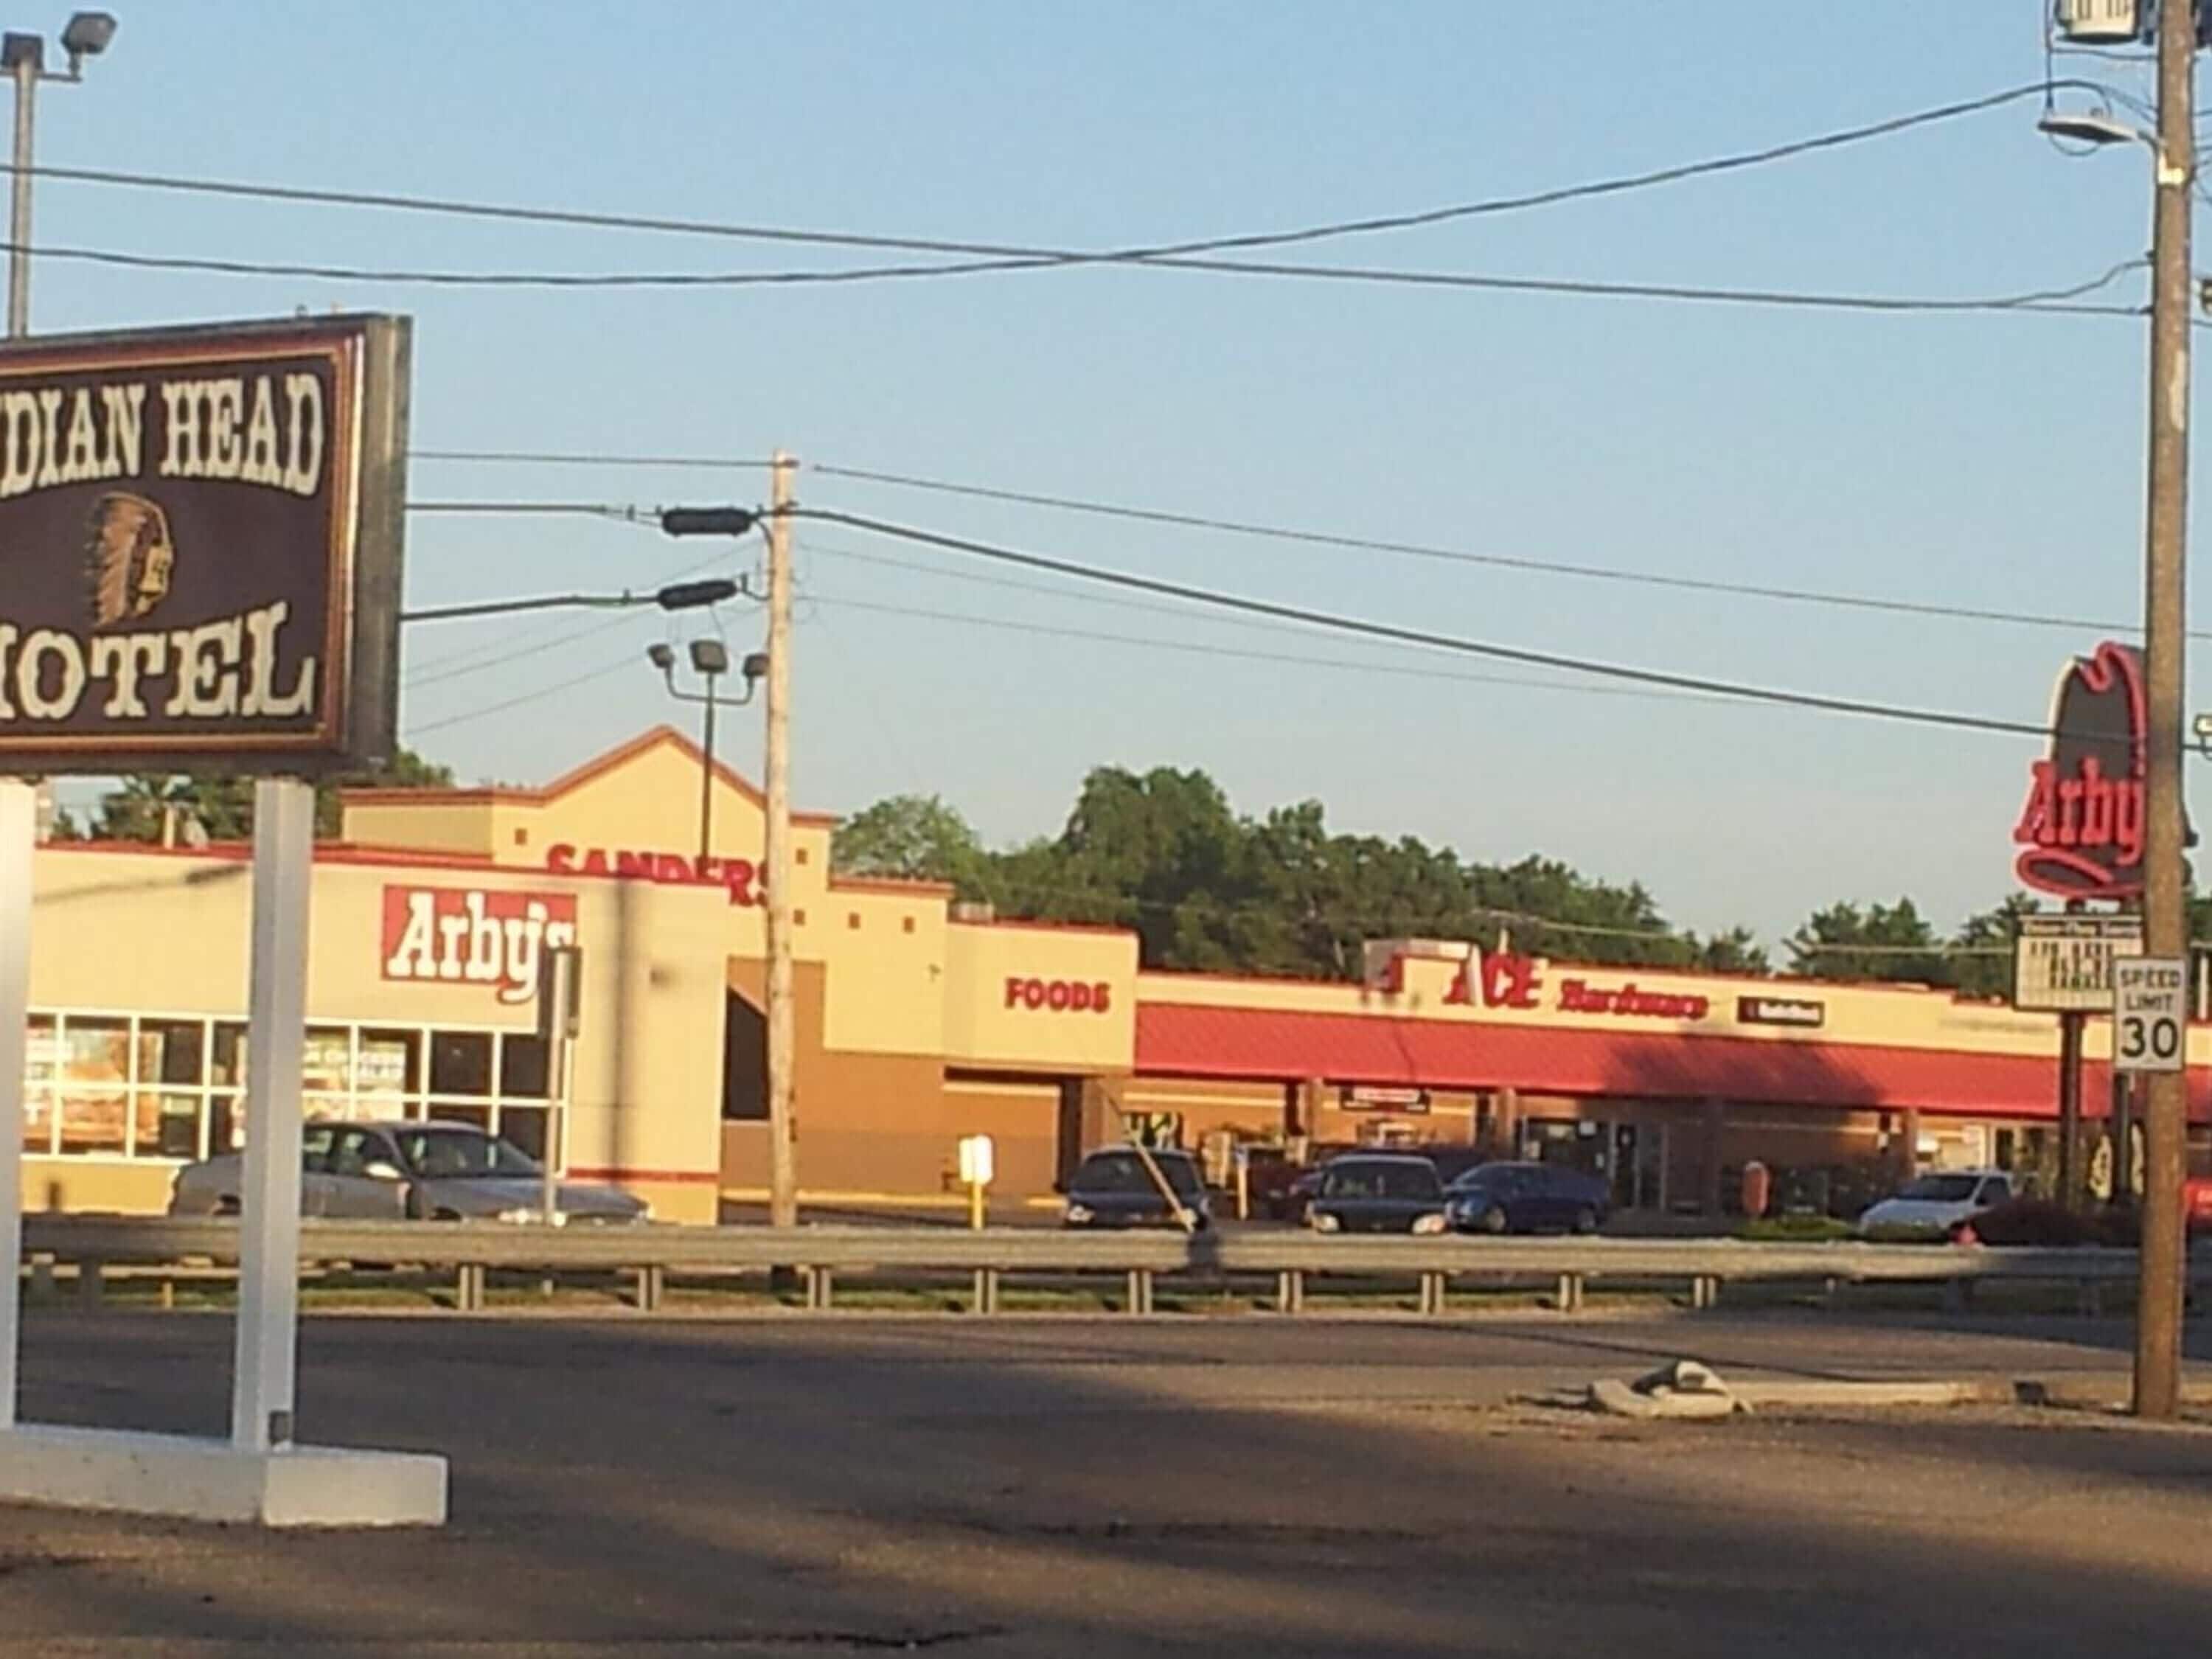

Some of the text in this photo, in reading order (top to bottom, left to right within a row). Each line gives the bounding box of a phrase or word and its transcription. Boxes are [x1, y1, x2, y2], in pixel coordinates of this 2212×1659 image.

[160, 373, 324, 496] HEAD
[1005, 978, 1110, 1012] FOODS
[1441, 950, 1543, 1008] ACE
[2120, 968, 2180, 988] SPEED
[2126, 994, 2172, 1011] LIMIT
[2121, 1016, 2178, 1059] 30
